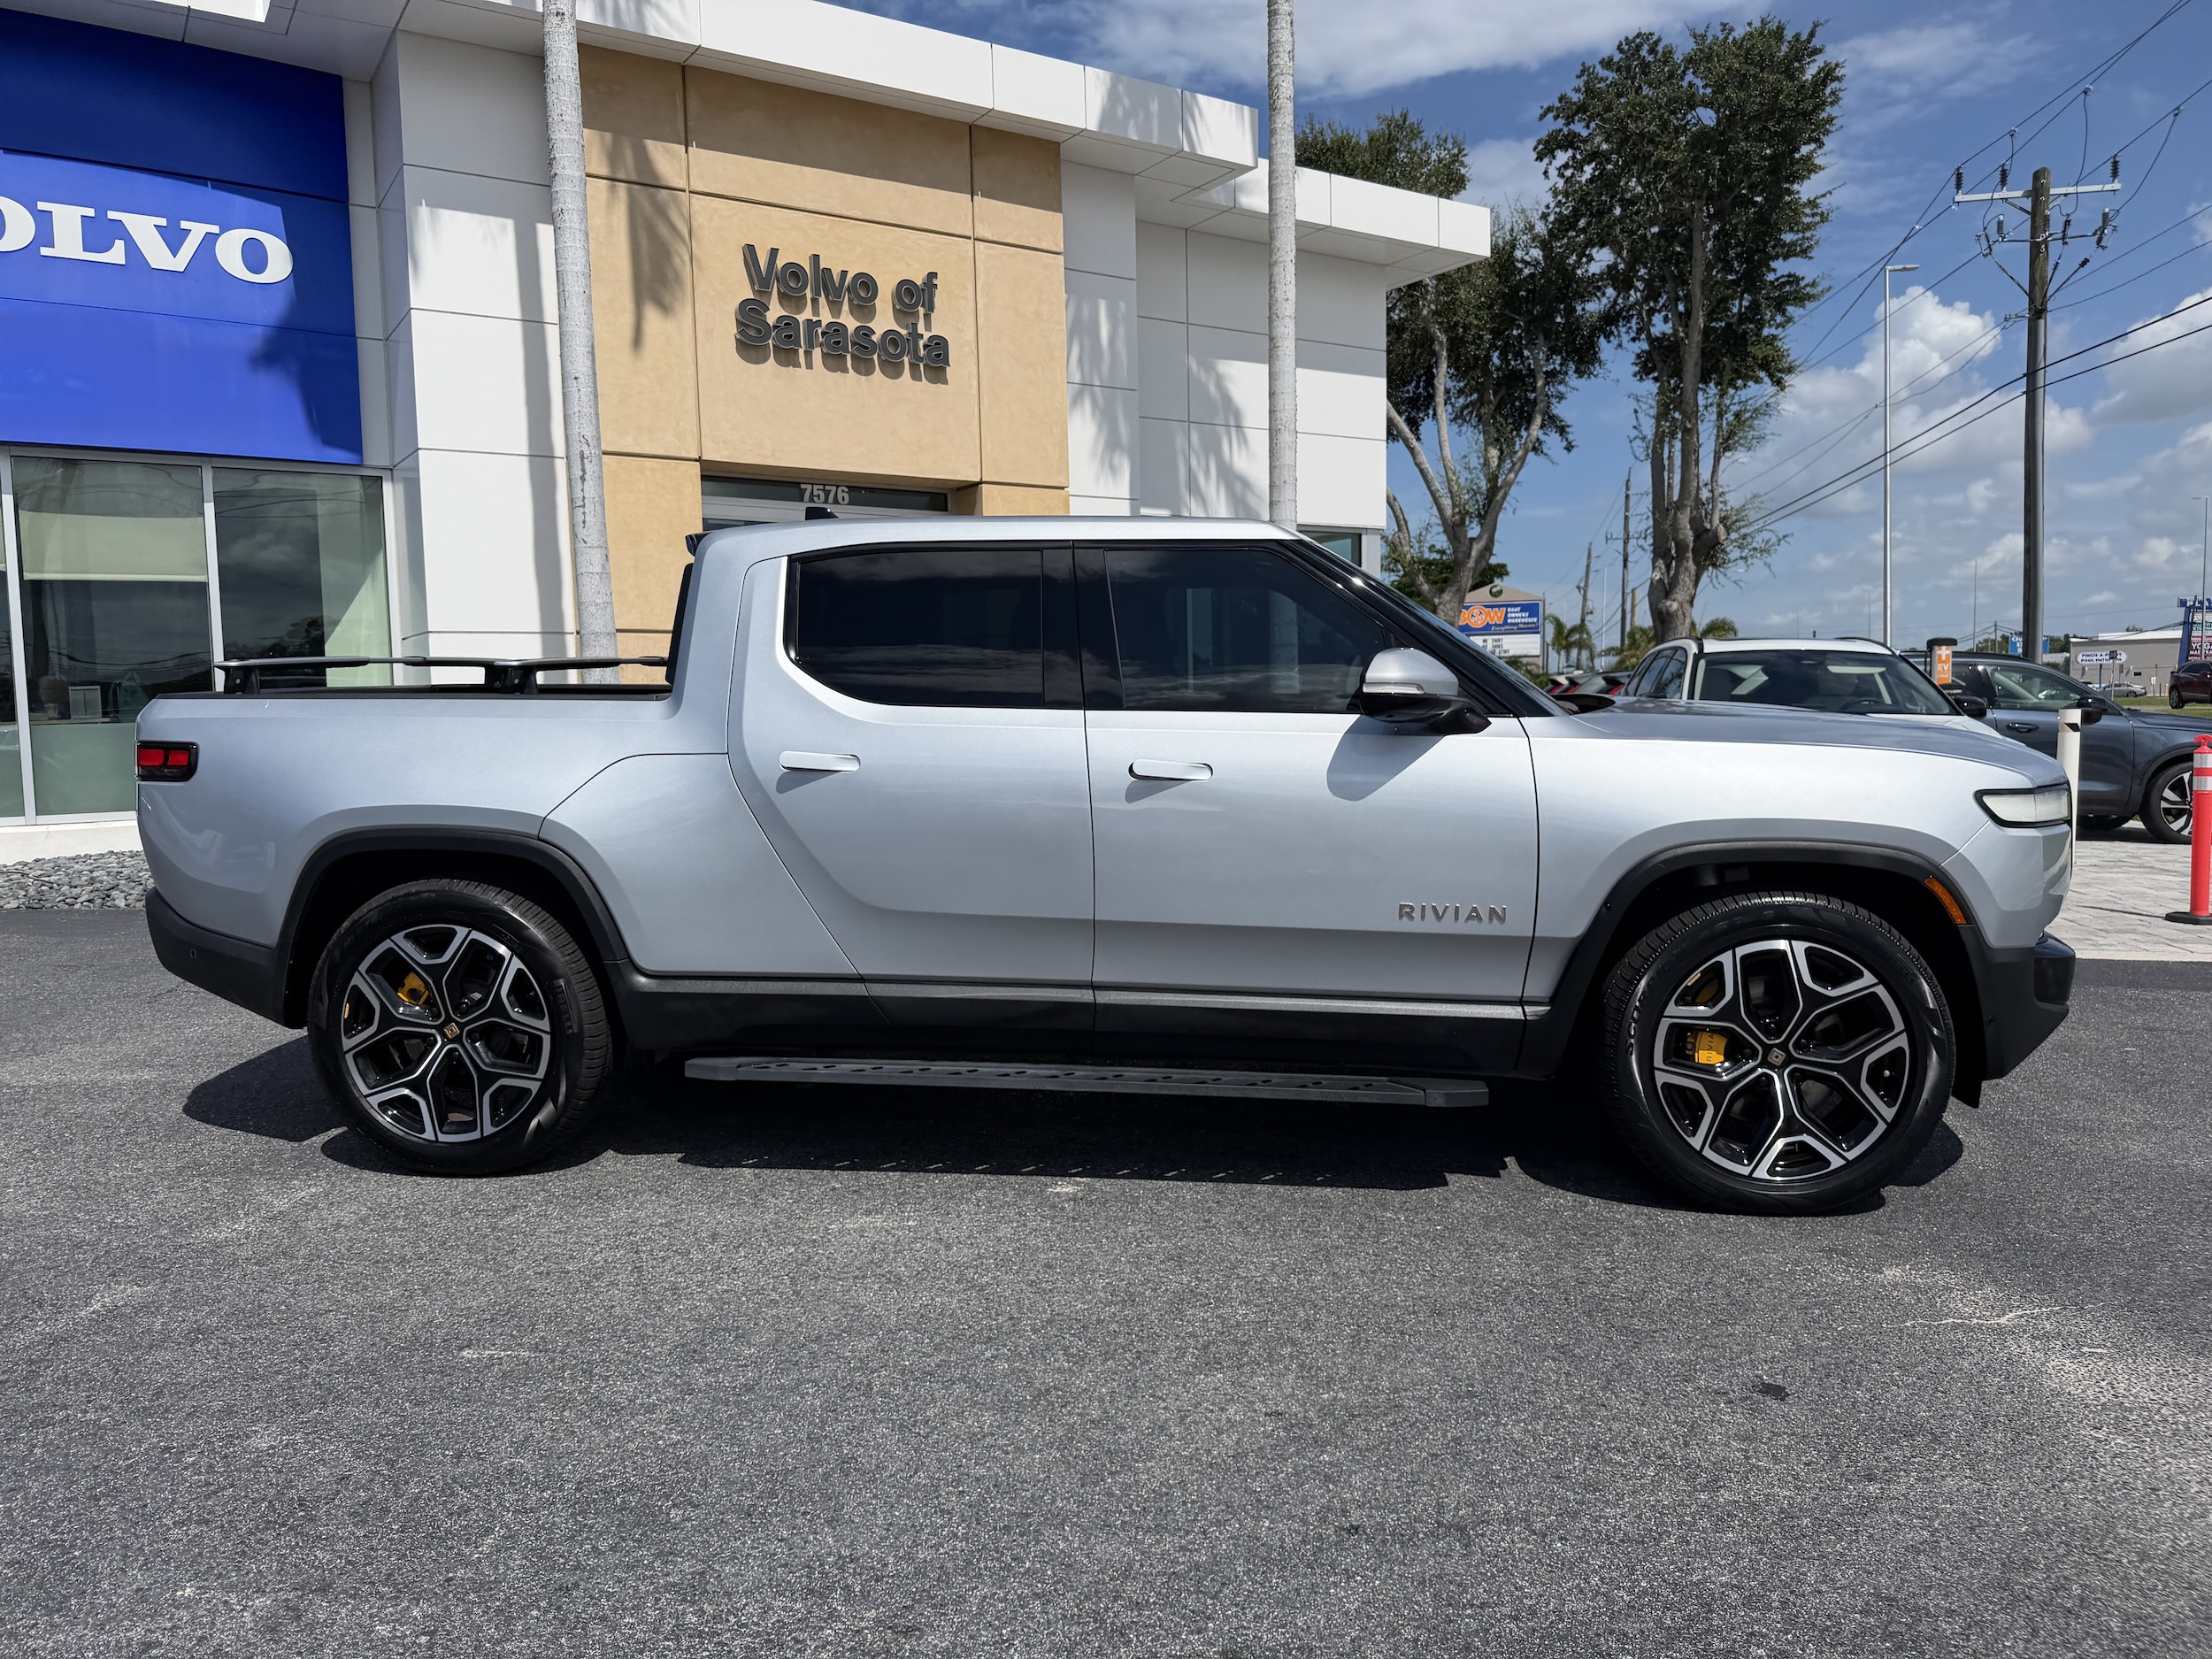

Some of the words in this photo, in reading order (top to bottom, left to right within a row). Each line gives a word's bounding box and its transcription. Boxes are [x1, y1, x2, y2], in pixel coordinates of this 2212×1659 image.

[742, 243, 879, 306] Volvo
[891, 272, 938, 314] of
[734, 297, 951, 367] Sarasota
[800, 483, 849, 506] 7576
[1398, 902, 1507, 925] RIVIAN
[1706, 1033, 1715, 1062] RIVIA
